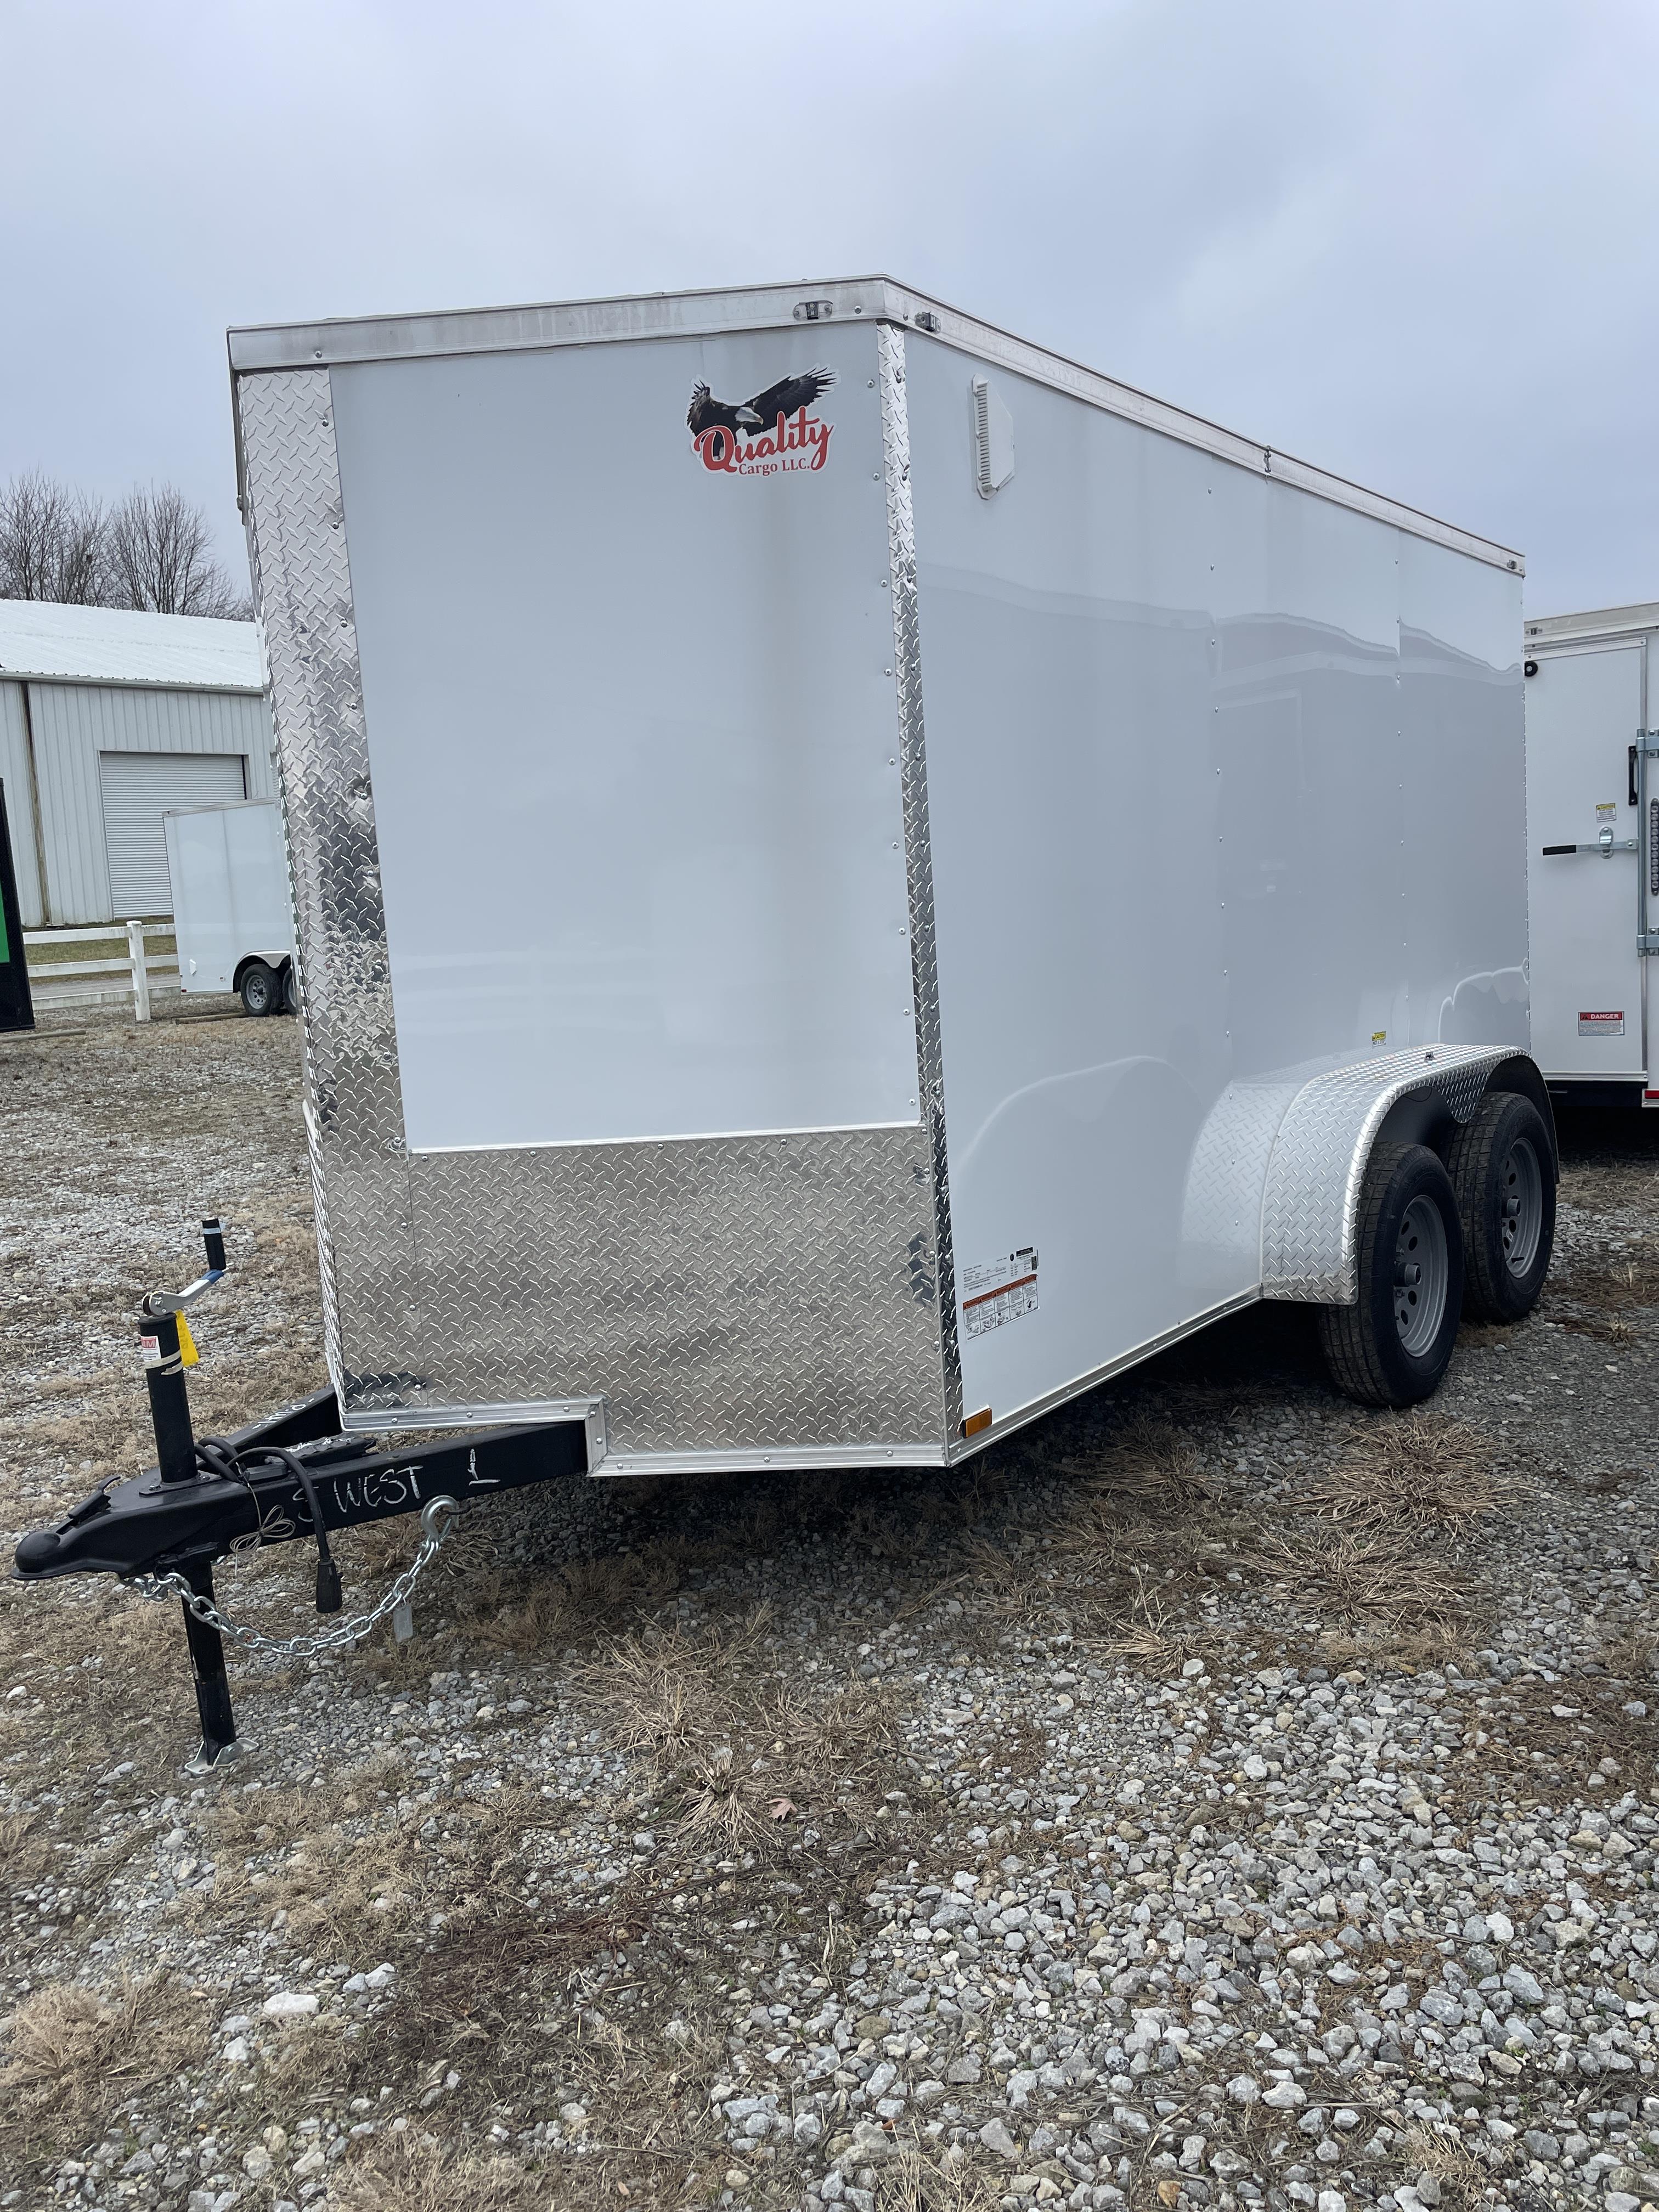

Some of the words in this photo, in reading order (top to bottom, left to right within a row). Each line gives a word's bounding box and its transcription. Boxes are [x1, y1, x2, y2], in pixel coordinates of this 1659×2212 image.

[693, 406, 834, 473] Quality
[739, 464, 778, 476] Cargo
[782, 458, 810, 471] LLC.
[334, 1465, 424, 1513] WEST
